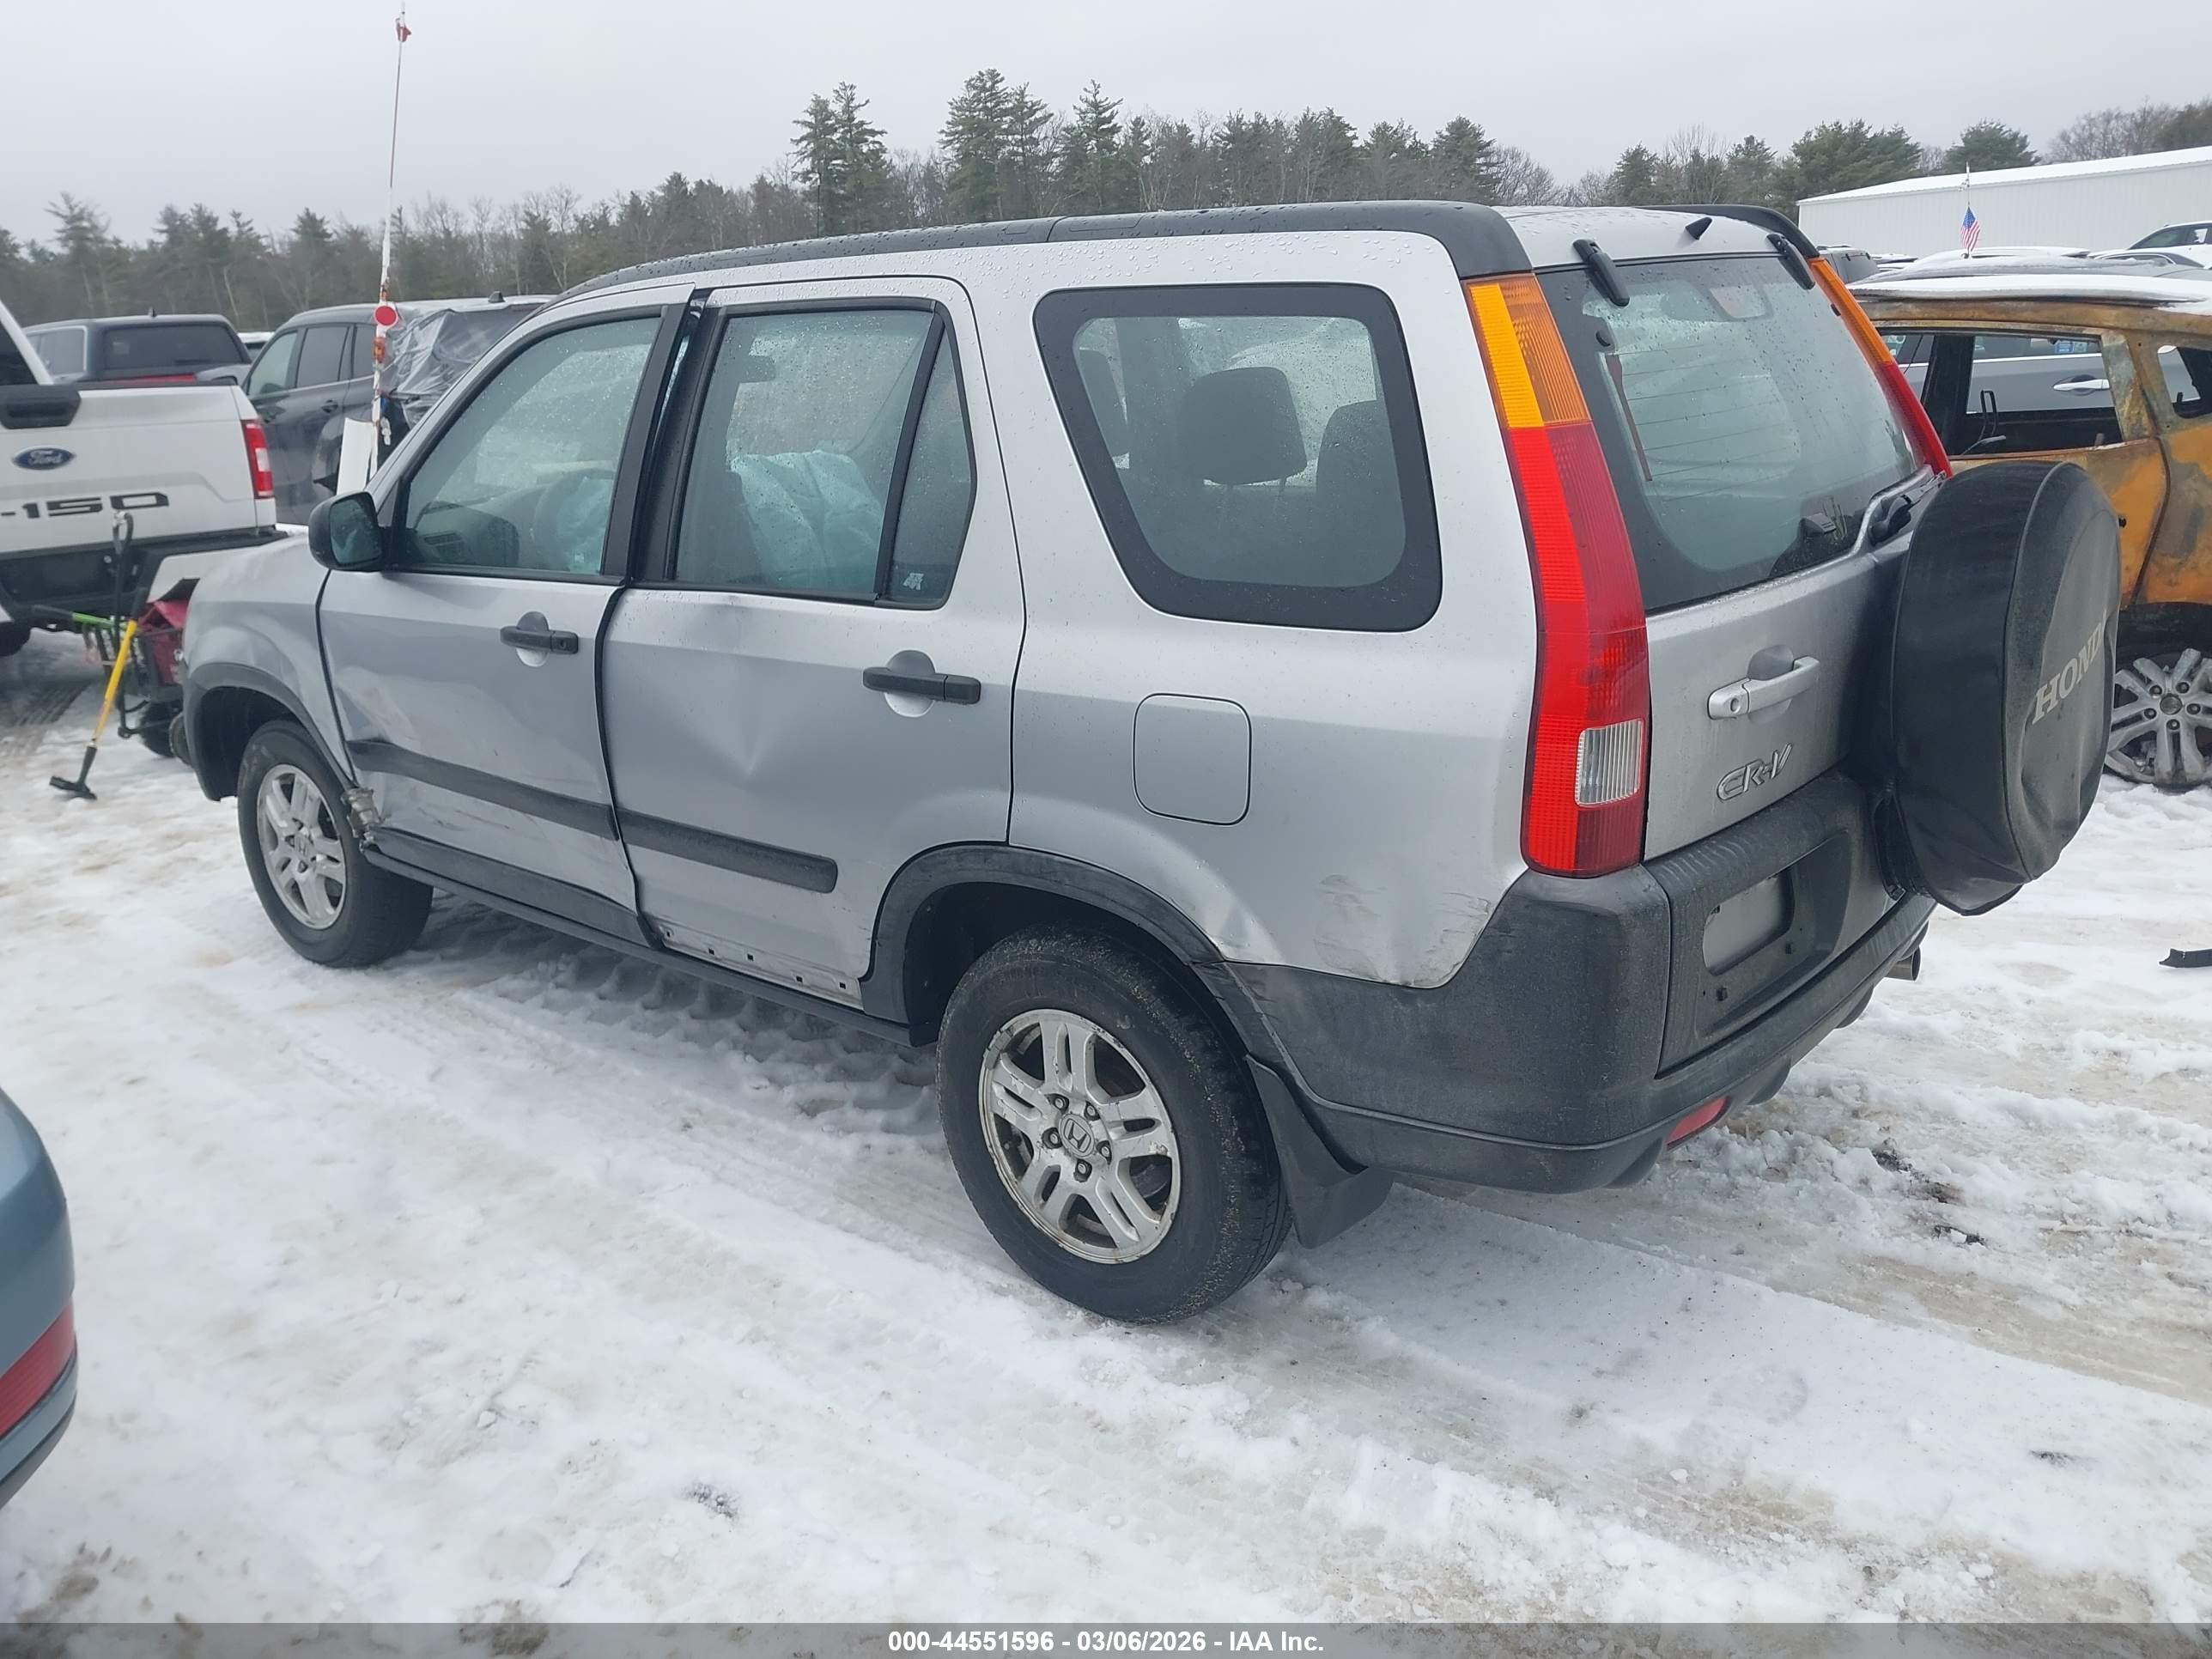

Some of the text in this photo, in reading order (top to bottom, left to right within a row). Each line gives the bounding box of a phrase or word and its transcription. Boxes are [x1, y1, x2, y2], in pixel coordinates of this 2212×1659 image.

[28, 449, 63, 465] Ford
[2032, 612, 2107, 725] HOND
[1717, 743, 1793, 801] CR-V
